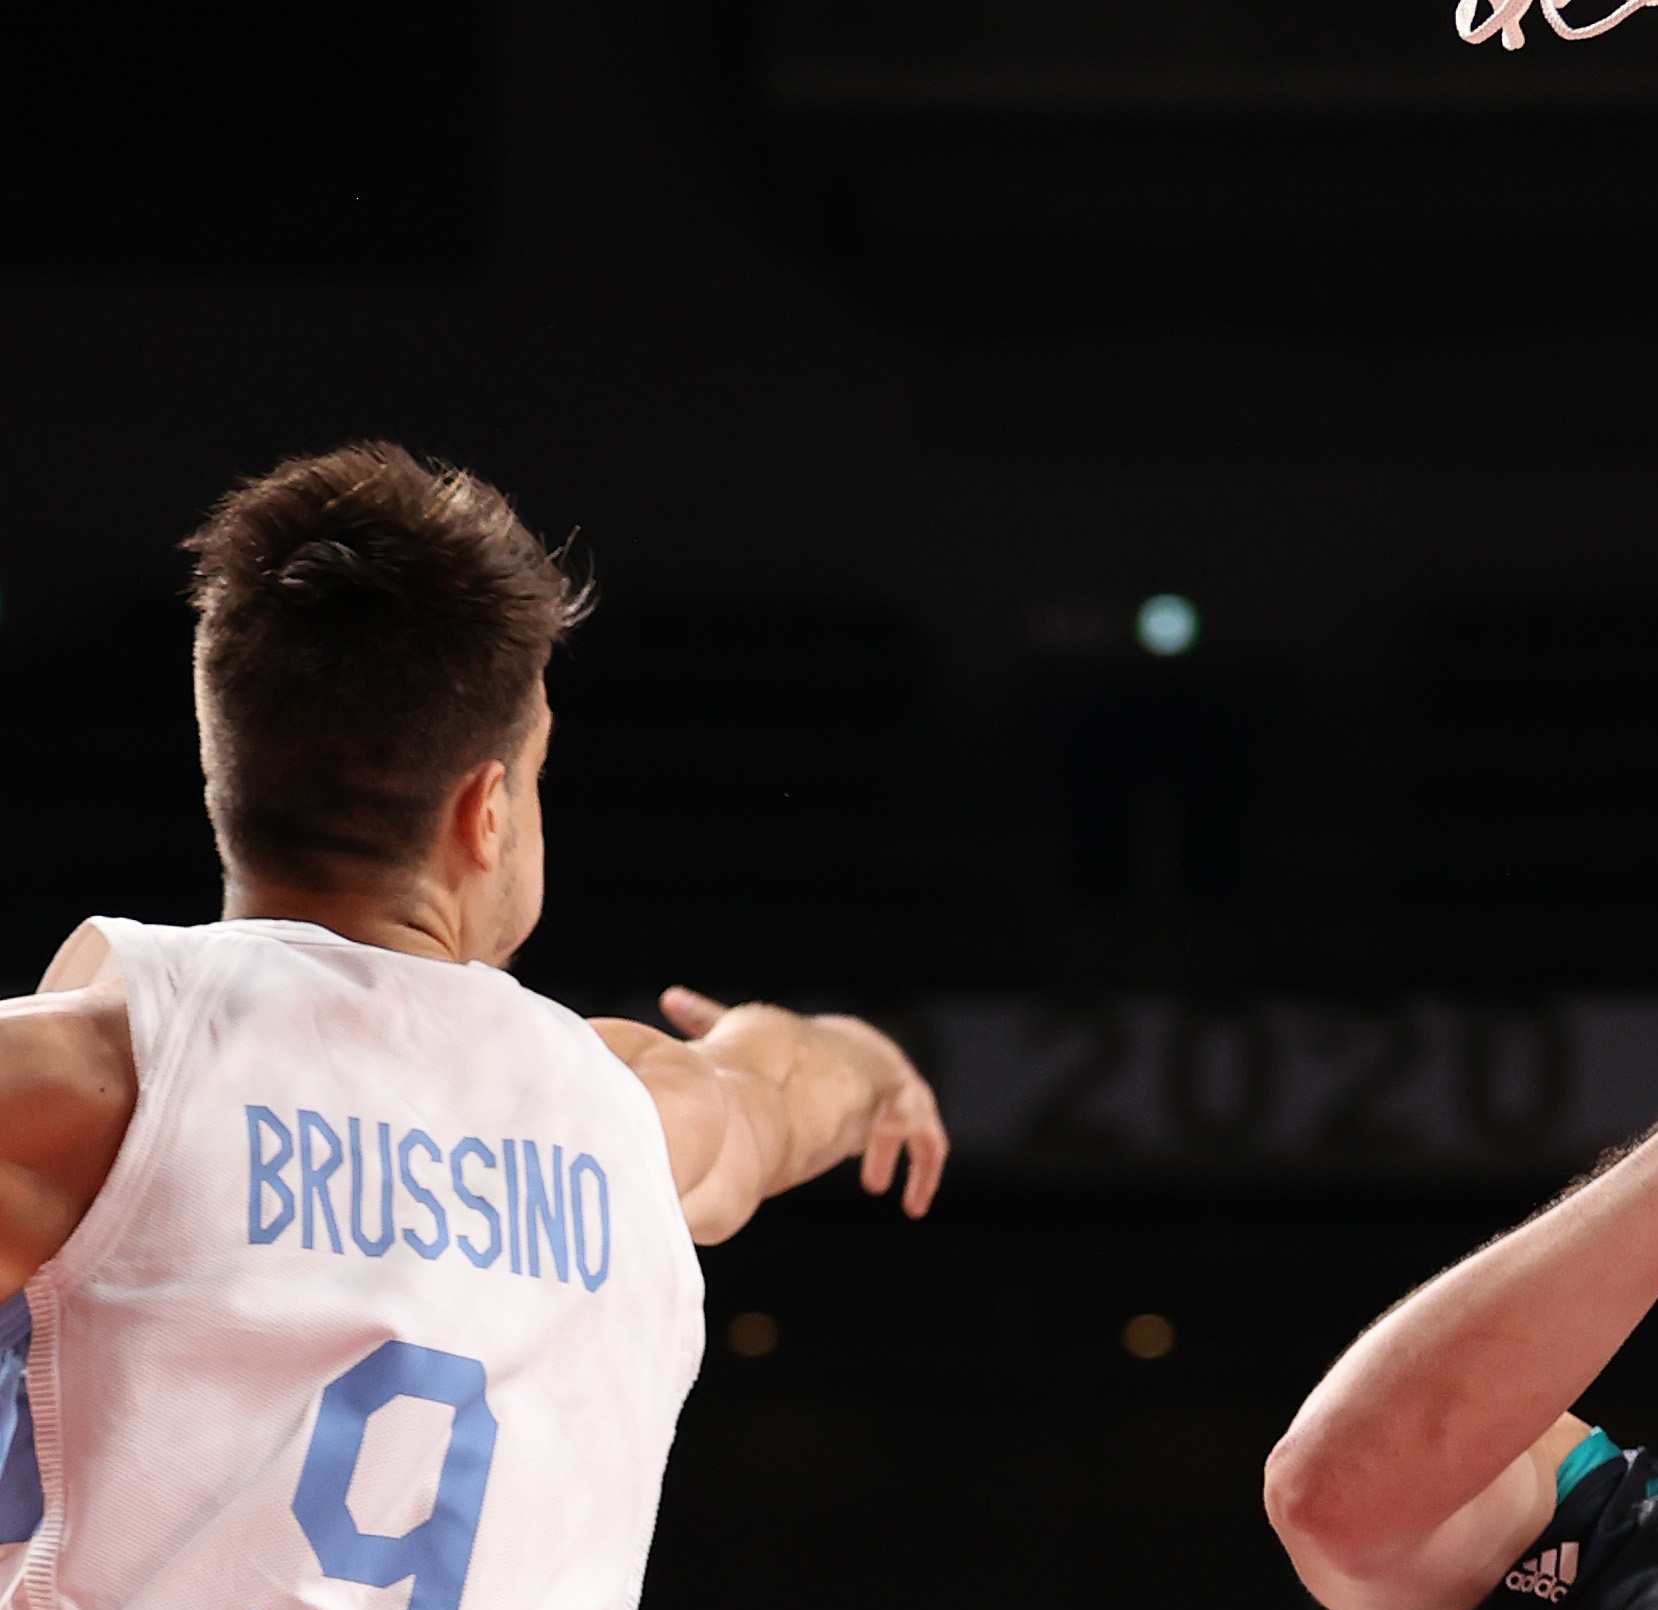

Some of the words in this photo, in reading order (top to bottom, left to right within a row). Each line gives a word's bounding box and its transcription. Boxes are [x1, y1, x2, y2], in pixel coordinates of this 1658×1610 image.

[1010, 992, 1577, 1160] 2020
[245, 1105, 610, 1292] BRUSSINO
[1505, 1570, 1568, 1604] adida
